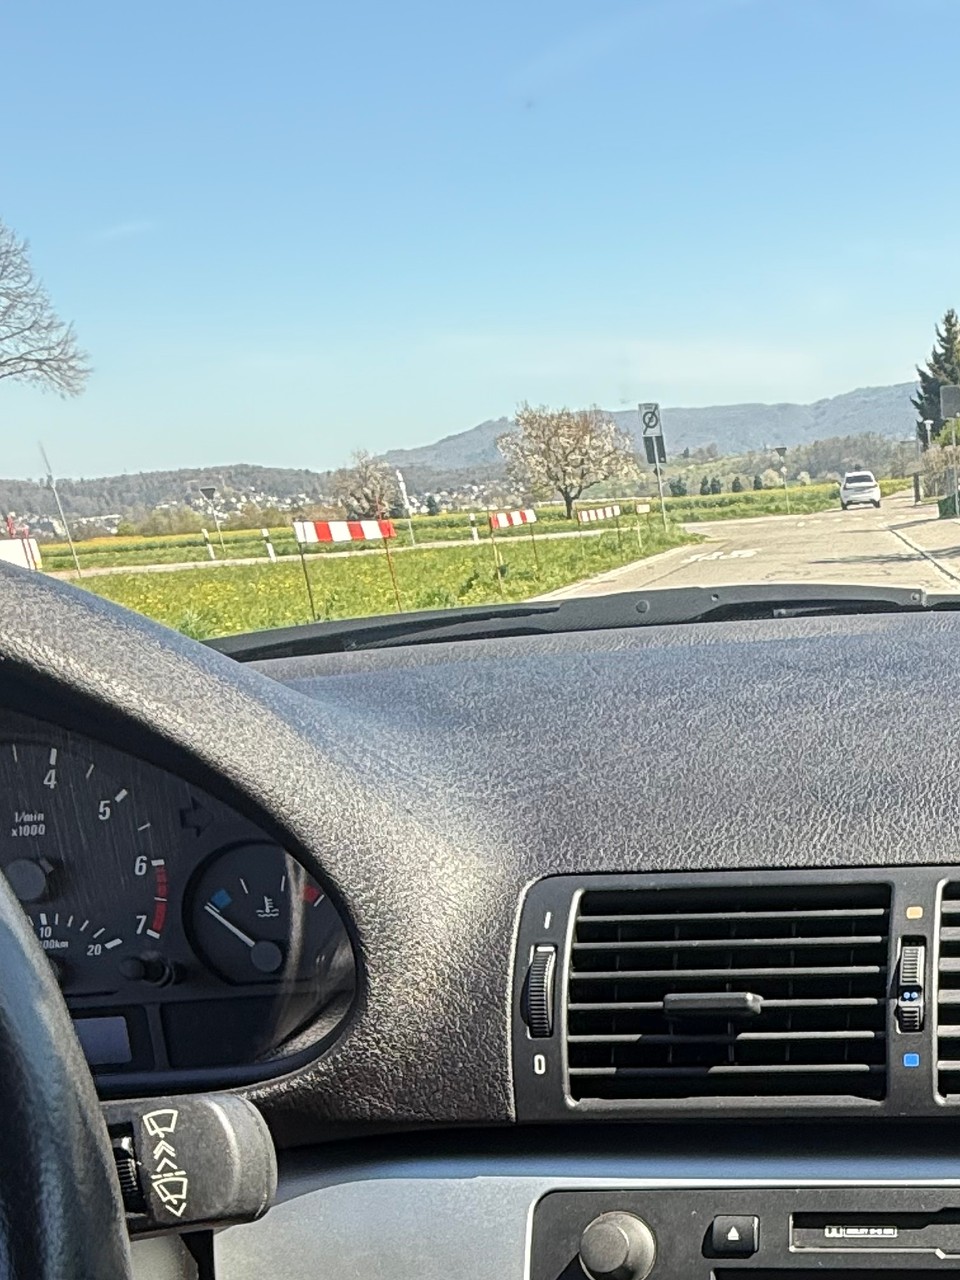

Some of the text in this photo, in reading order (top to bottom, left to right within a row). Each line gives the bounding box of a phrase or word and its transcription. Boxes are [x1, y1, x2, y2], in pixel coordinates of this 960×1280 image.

[43, 769, 57, 789] 4
[98, 800, 111, 820] 5
[12, 824, 46, 836] x1000
[134, 855, 147, 876] 6
[39, 926, 52, 939] 10
[136, 915, 147, 935] 7
[87, 944, 102, 956] 20
